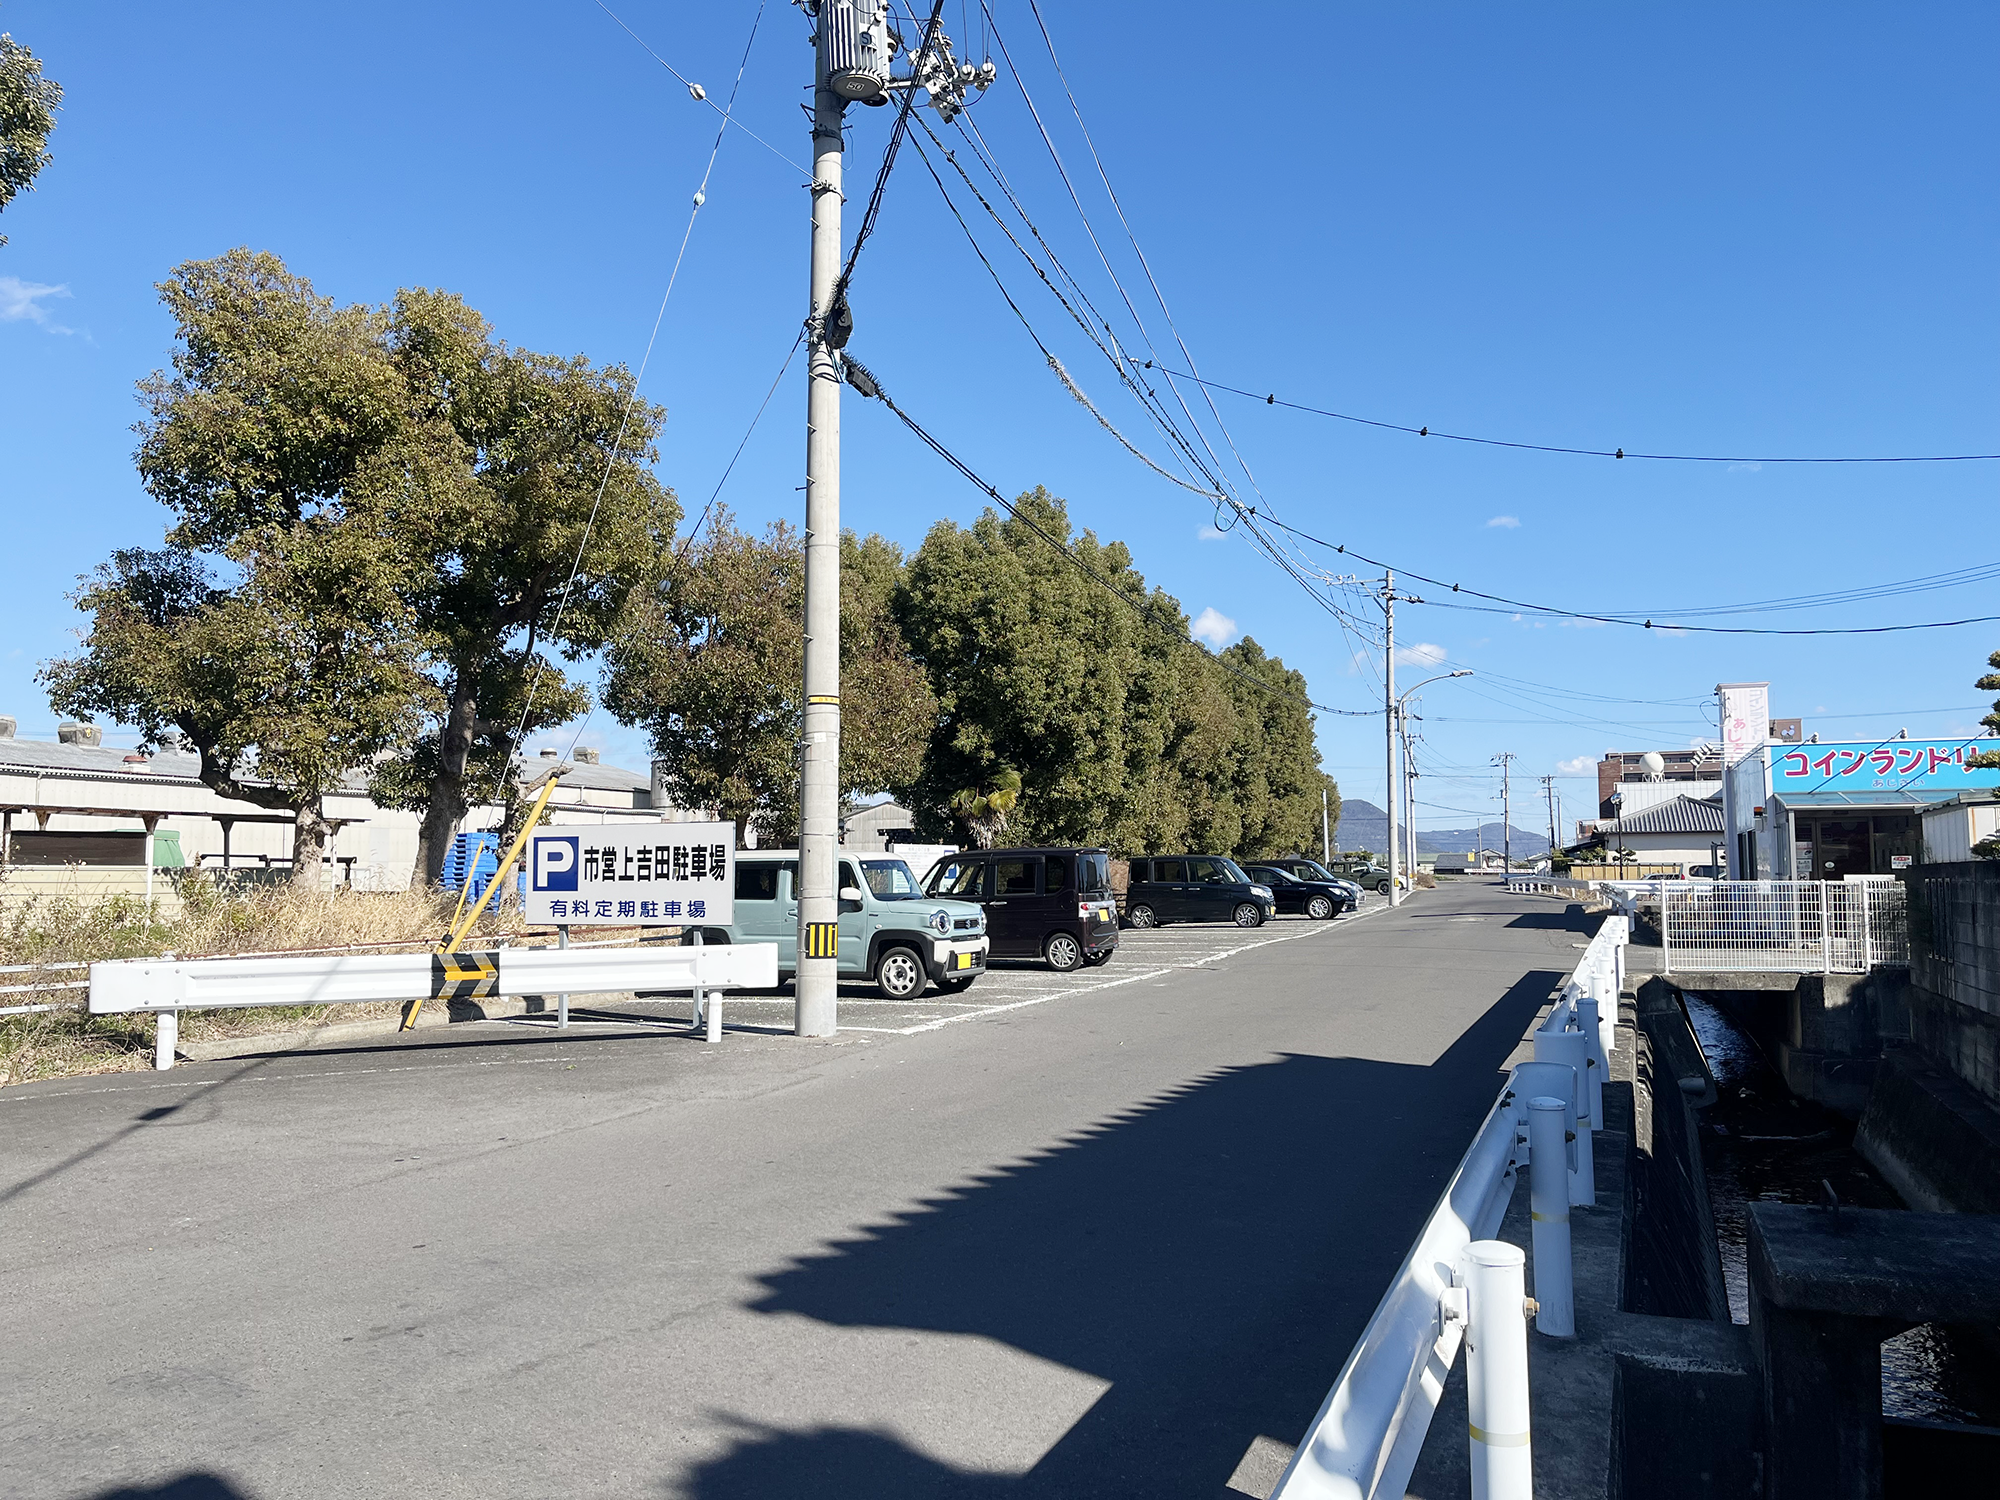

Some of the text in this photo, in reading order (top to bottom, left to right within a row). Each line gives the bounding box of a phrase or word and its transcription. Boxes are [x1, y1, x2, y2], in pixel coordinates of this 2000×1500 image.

[537, 841, 726, 887] P 市営上吉田駐車場
[549, 899, 707, 919] 有料定期駐車場
